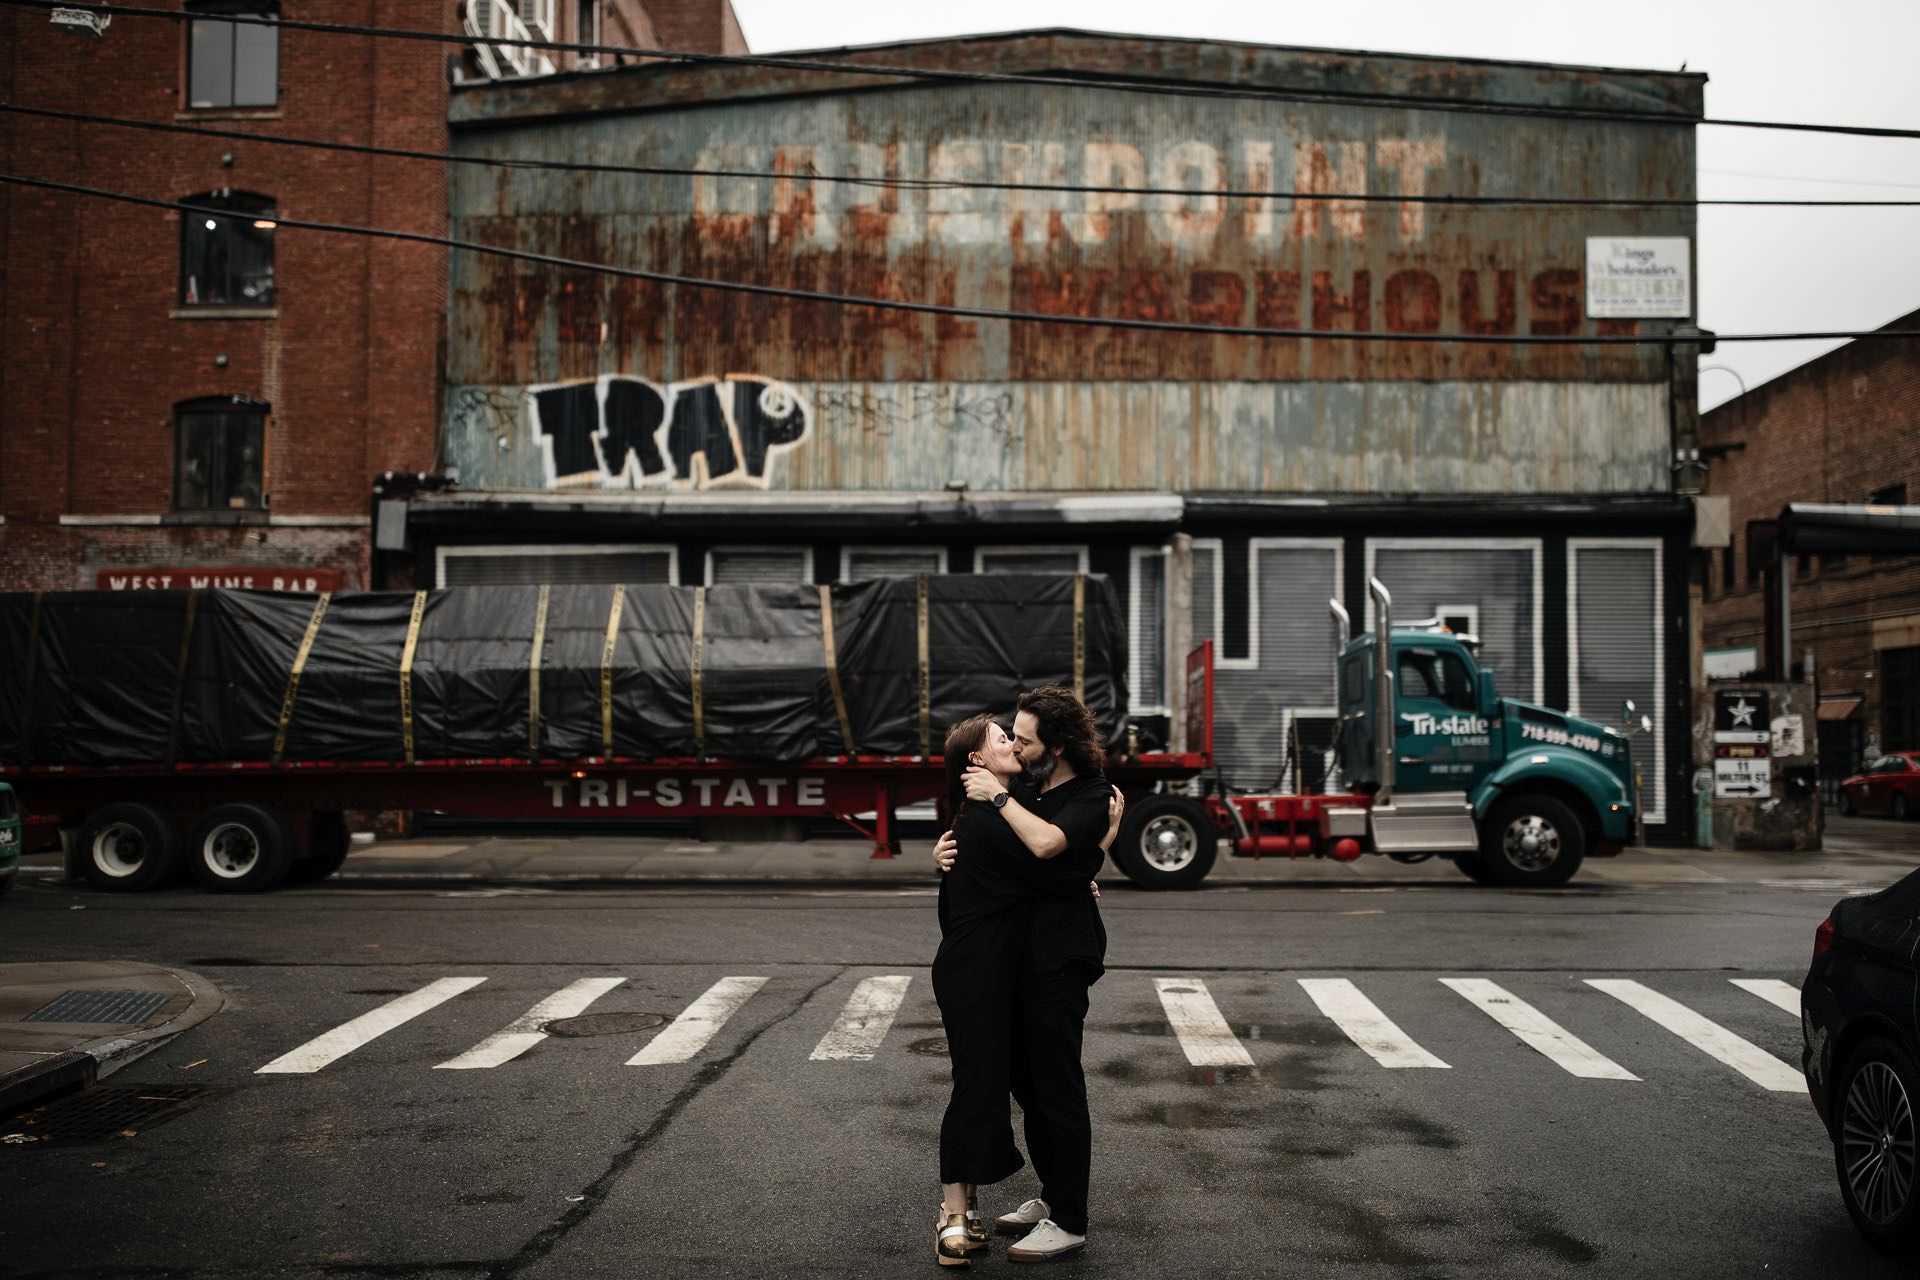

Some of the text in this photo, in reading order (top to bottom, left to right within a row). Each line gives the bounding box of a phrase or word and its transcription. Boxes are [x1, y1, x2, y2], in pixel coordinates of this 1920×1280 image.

[109, 576, 172, 590] WEST
[272, 577, 319, 593] BAR
[543, 778, 827, 807] TRI-STATE
